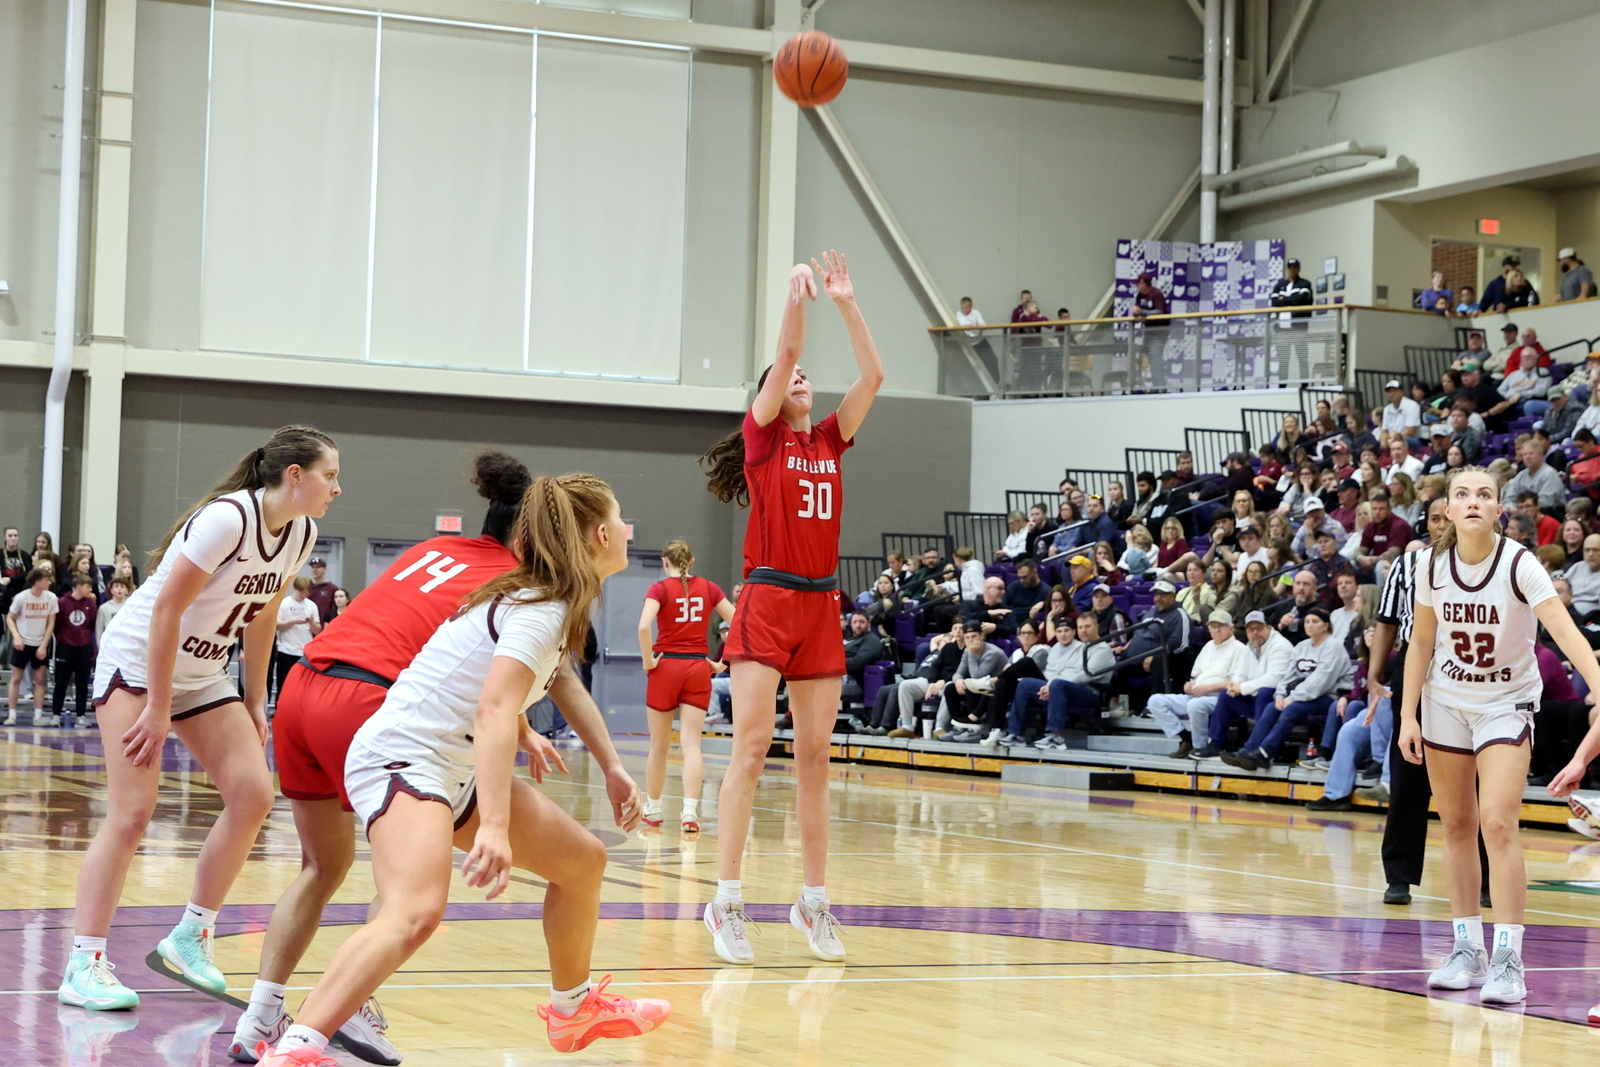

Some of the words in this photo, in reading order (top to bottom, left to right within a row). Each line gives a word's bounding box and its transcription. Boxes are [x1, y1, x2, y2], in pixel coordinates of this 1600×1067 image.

[786, 456, 837, 474] BELLEVUE
[797, 478, 832, 520] 30
[234, 572, 283, 595] GENOA
[392, 550, 470, 594] 14
[675, 596, 705, 623] 32
[1443, 601, 1500, 625] GENOA
[182, 635, 229, 660] COM
[1450, 631, 1496, 668] 22
